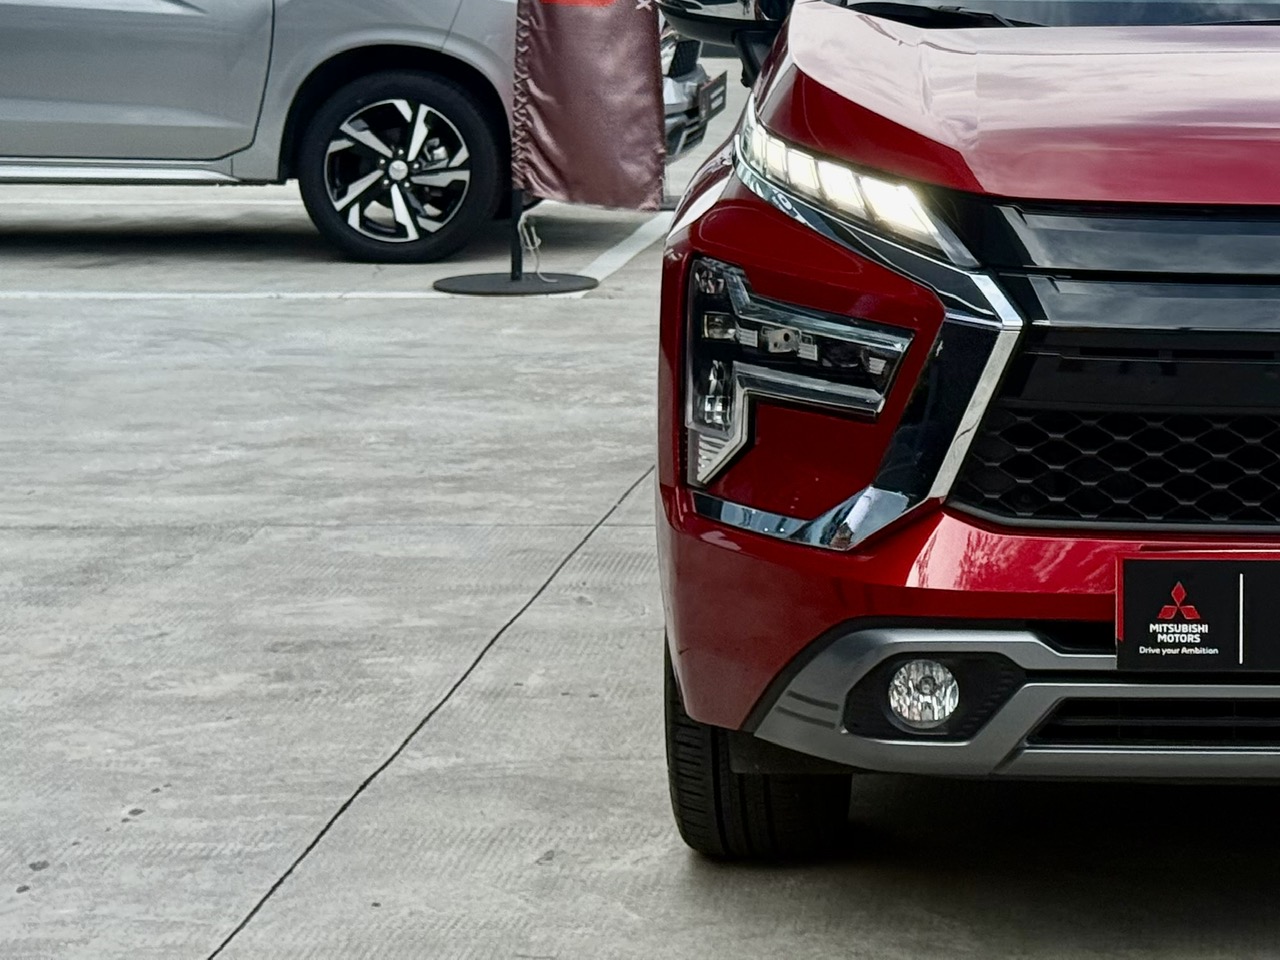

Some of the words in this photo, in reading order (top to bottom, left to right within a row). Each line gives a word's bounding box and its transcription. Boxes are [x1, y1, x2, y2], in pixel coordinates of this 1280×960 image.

[1149, 624, 1209, 633] MITSUBISHI
[1157, 634, 1201, 643] MOTORS
[1139, 646, 1160, 654] Drive
[1161, 647, 1180, 655] your
[1181, 646, 1219, 654] Ambition
